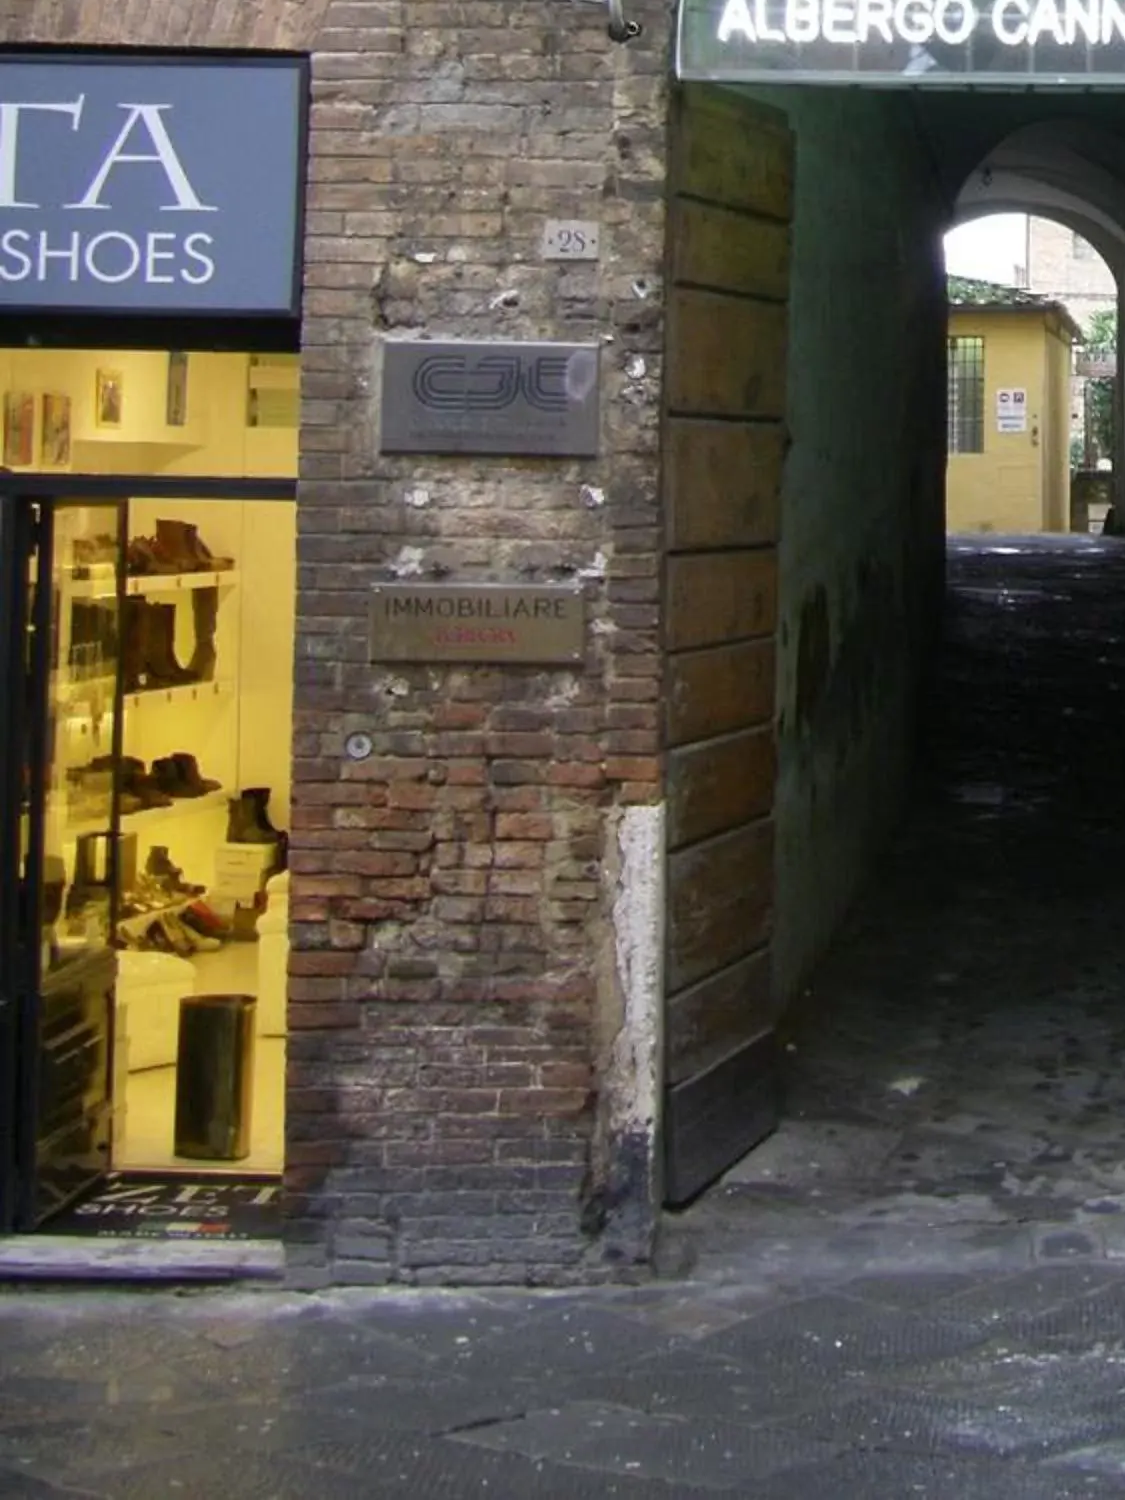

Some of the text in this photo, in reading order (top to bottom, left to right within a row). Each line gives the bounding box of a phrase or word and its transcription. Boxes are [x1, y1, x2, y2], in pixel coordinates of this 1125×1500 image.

[0, 229, 214, 284] SHOES
[384, 597, 568, 619] IMMOBILIARE
[74, 1203, 230, 1218] SHOES
